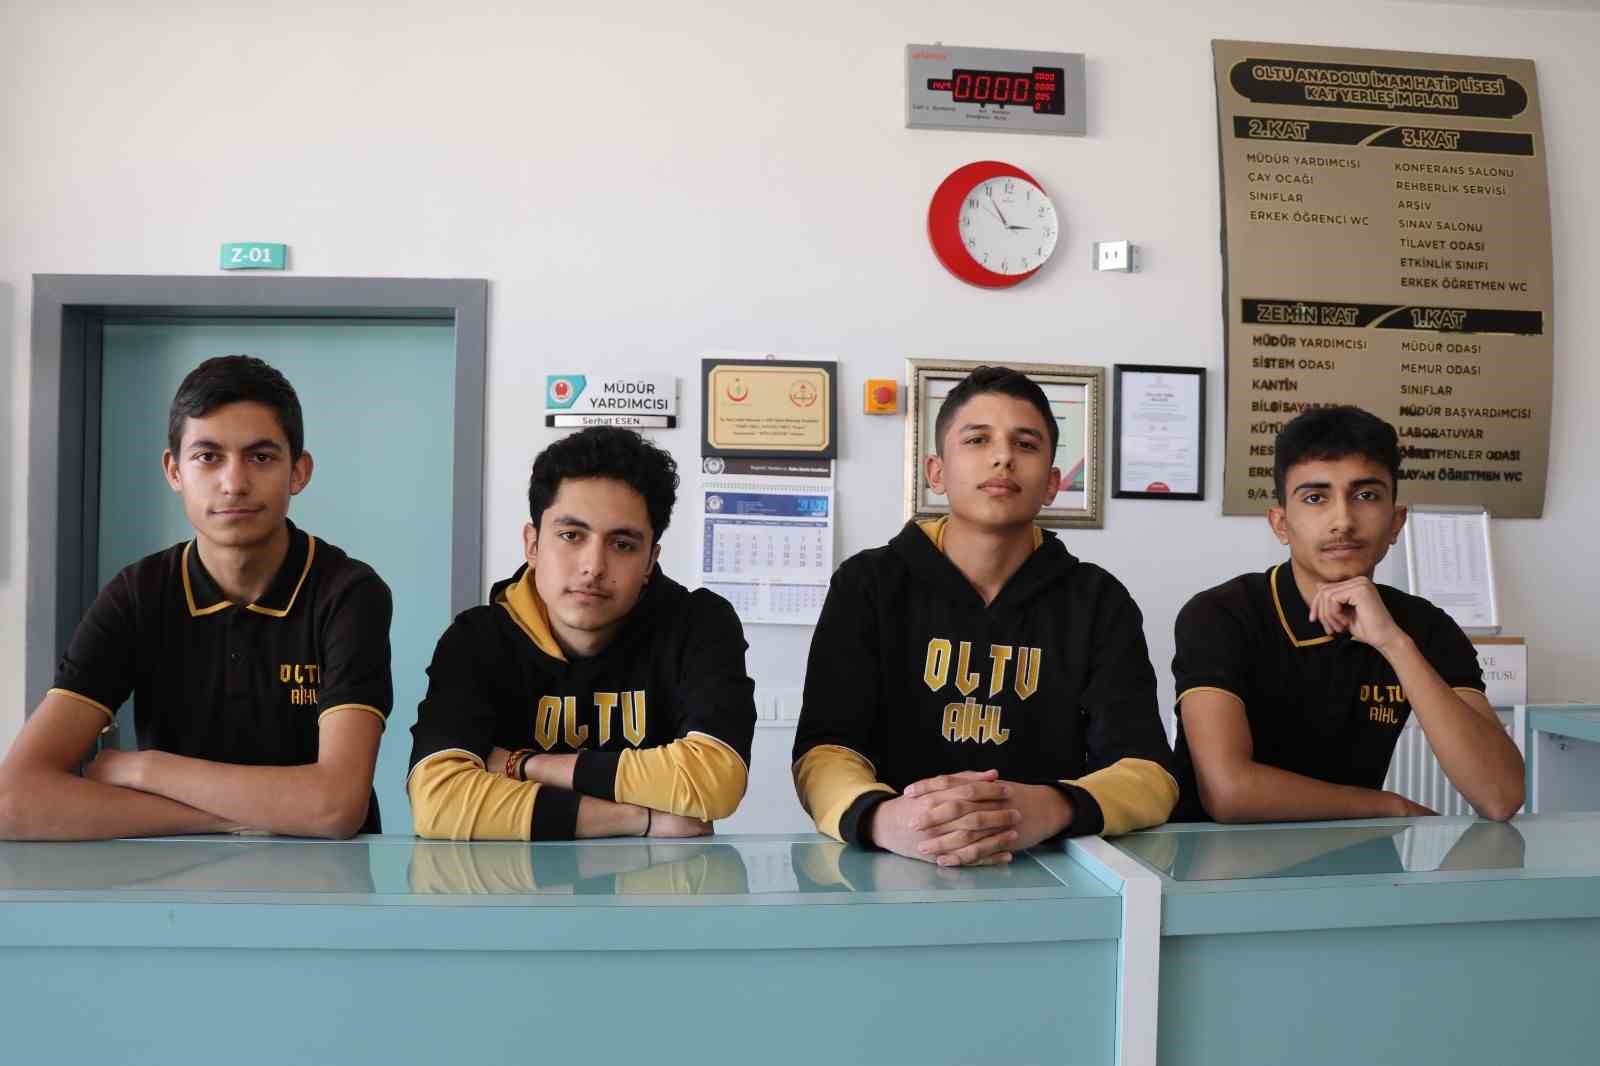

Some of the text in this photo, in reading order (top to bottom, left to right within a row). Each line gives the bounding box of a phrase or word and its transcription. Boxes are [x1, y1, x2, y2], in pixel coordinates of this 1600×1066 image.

[1252, 65, 1506, 96] OLTU ANADOLU İMAM HATİP LİSESİ
[955, 75, 1029, 102] 0000
[1305, 85, 1459, 109] KAT YERLEŞİM PLANI
[1248, 119, 1310, 140] 2.KAT
[1401, 128, 1460, 149] 3.KAT
[1247, 151, 1360, 168] MÜDÜR YARDIMCISI
[1394, 162, 1514, 178] KONFERANS SALONU
[1247, 172, 1313, 184] ÇAY OCAĞI
[1249, 191, 1304, 203] SINIFLAR
[1250, 210, 1290, 221] ERKEK
[1350, 216, 1369, 226] WC
[1398, 219, 1483, 232] SINAV SALONU
[1449, 240, 1485, 251] ODASI
[231, 247, 272, 263] Z-01
[1456, 260, 1488, 271] SINIFI
[1400, 277, 1528, 292] ERKEK ÖĞRETMEN WC
[1257, 303, 1359, 325] ZEMİN KAT
[1410, 308, 1467, 329] 1.KAT
[1252, 333, 1367, 350] MÜDÜR YARDIMCISI
[1401, 340, 1481, 354] MÜDÜR ODASI
[1252, 356, 1335, 370] SİSTEM ODASI
[1400, 363, 1481, 376] MEMUR ODASI
[604, 380, 655, 394] MÜDÜR
[1252, 378, 1298, 391] KANTİN
[1400, 384, 1453, 396] SINIFLAR
[590, 398, 668, 410] YARDIMCISI
[1399, 404, 1531, 419] MÜDÜR BAŞYARDIMCISI
[582, 416, 640, 425] Serhat ESEN
[1250, 421, 1288, 434] KÜTÜ
[1399, 426, 1484, 440] LABORATUVAR
[1249, 446, 1275, 456] MES
[1399, 445, 1521, 461] ÖĞRETMENLER ODASI
[1248, 467, 1274, 478] ERK
[1398, 467, 1523, 483] BAYAN ÖĞRETMEN WC
[923, 637, 1042, 701] OLTU
[1482, 671, 1517, 681] UTUSU
[1359, 684, 1406, 703] OLTU
[535, 689, 646, 751] OLTU
[941, 696, 1011, 745] AİHL
